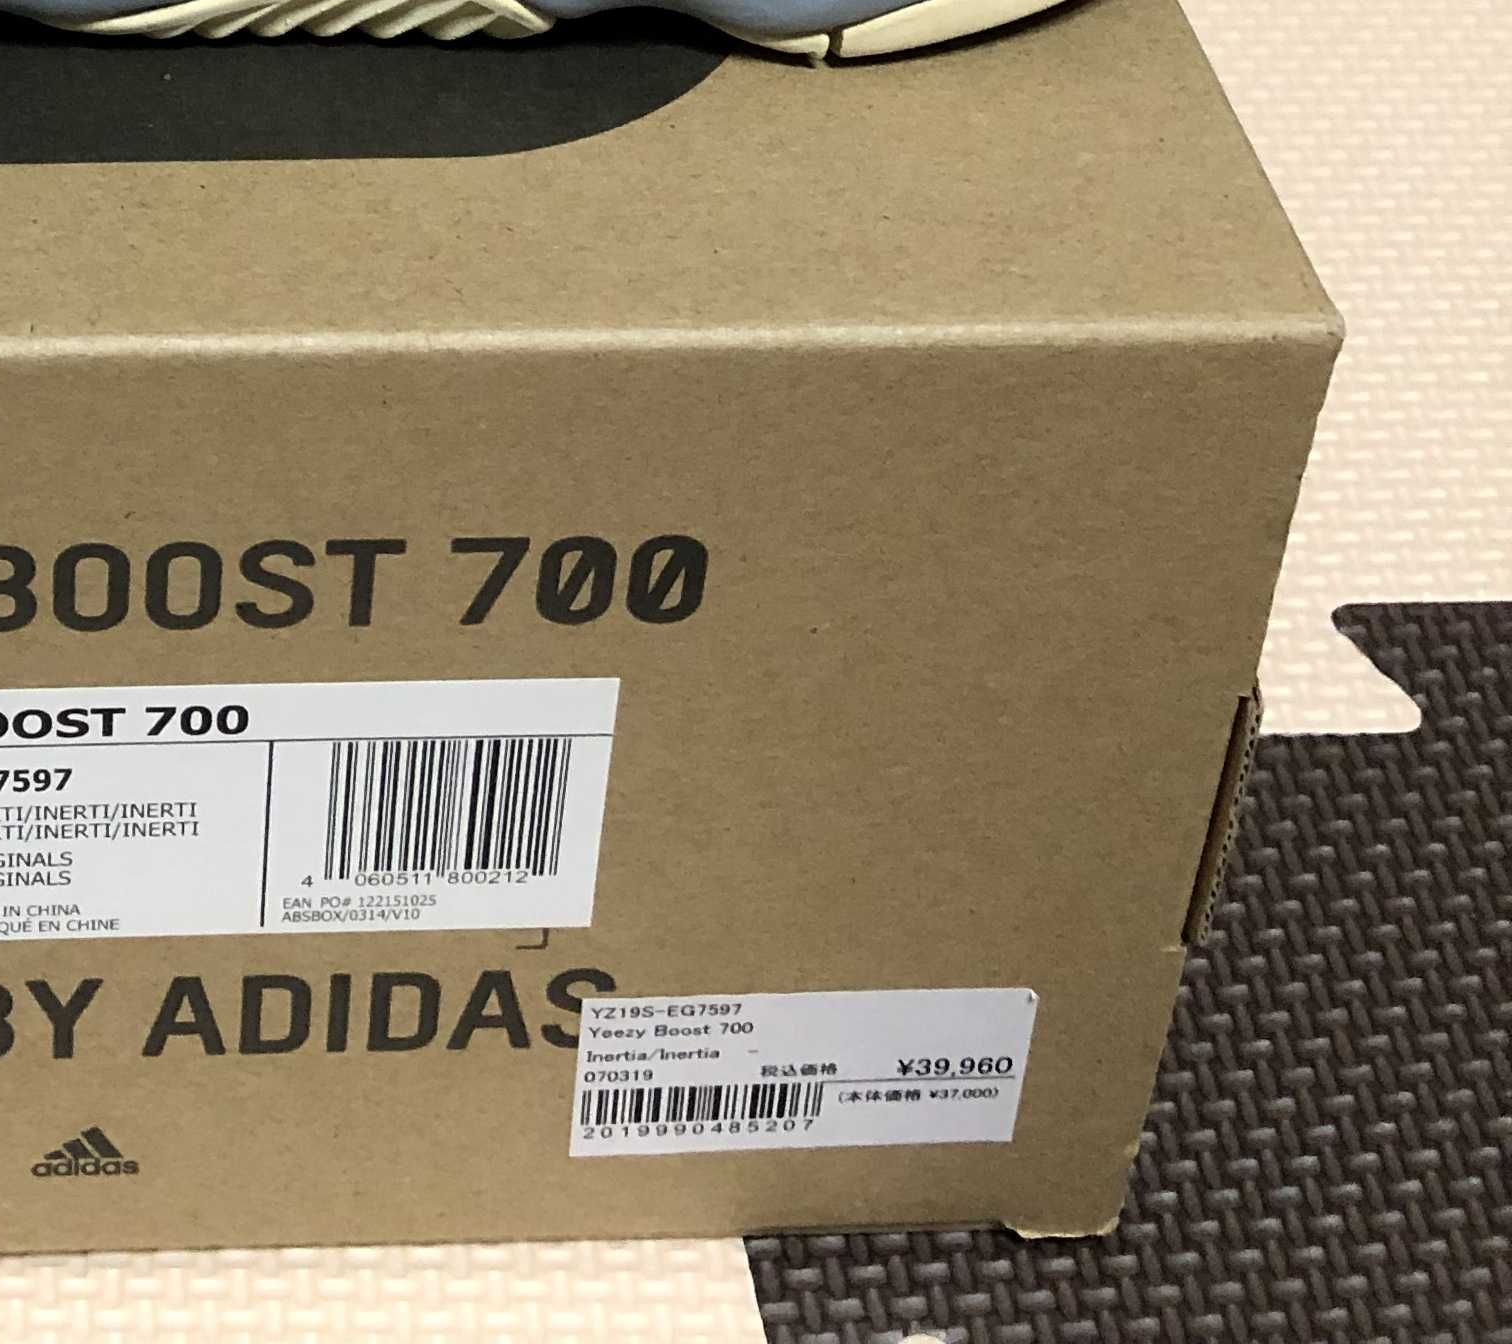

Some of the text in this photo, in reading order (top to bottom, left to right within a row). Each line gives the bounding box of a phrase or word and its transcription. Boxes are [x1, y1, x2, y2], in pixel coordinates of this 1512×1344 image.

[451, 534, 709, 626] 700
[145, 705, 249, 736] 700
[301, 870, 529, 888] 4 060511 800212
[3, 905, 21, 917] IN
[27, 904, 81, 916] CHINA
[282, 895, 437, 909] EAN PO# 122151025
[38, 920, 61, 932] EN
[67, 919, 120, 932] CHINE
[142, 967, 617, 1058] ADIDAS
[591, 1003, 742, 1020] YZ19S-EG7597
[588, 1021, 754, 1039] Yeezy Boost 700
[586, 1048, 721, 1063] Inertia/Inertia
[584, 1069, 654, 1083] 070319
[760, 1062, 838, 1078] 税込価格
[897, 1057, 1014, 1078] ¥39,960
[583, 1119, 814, 1140] 2019990485207
[31, 1158, 140, 1177] adidas
